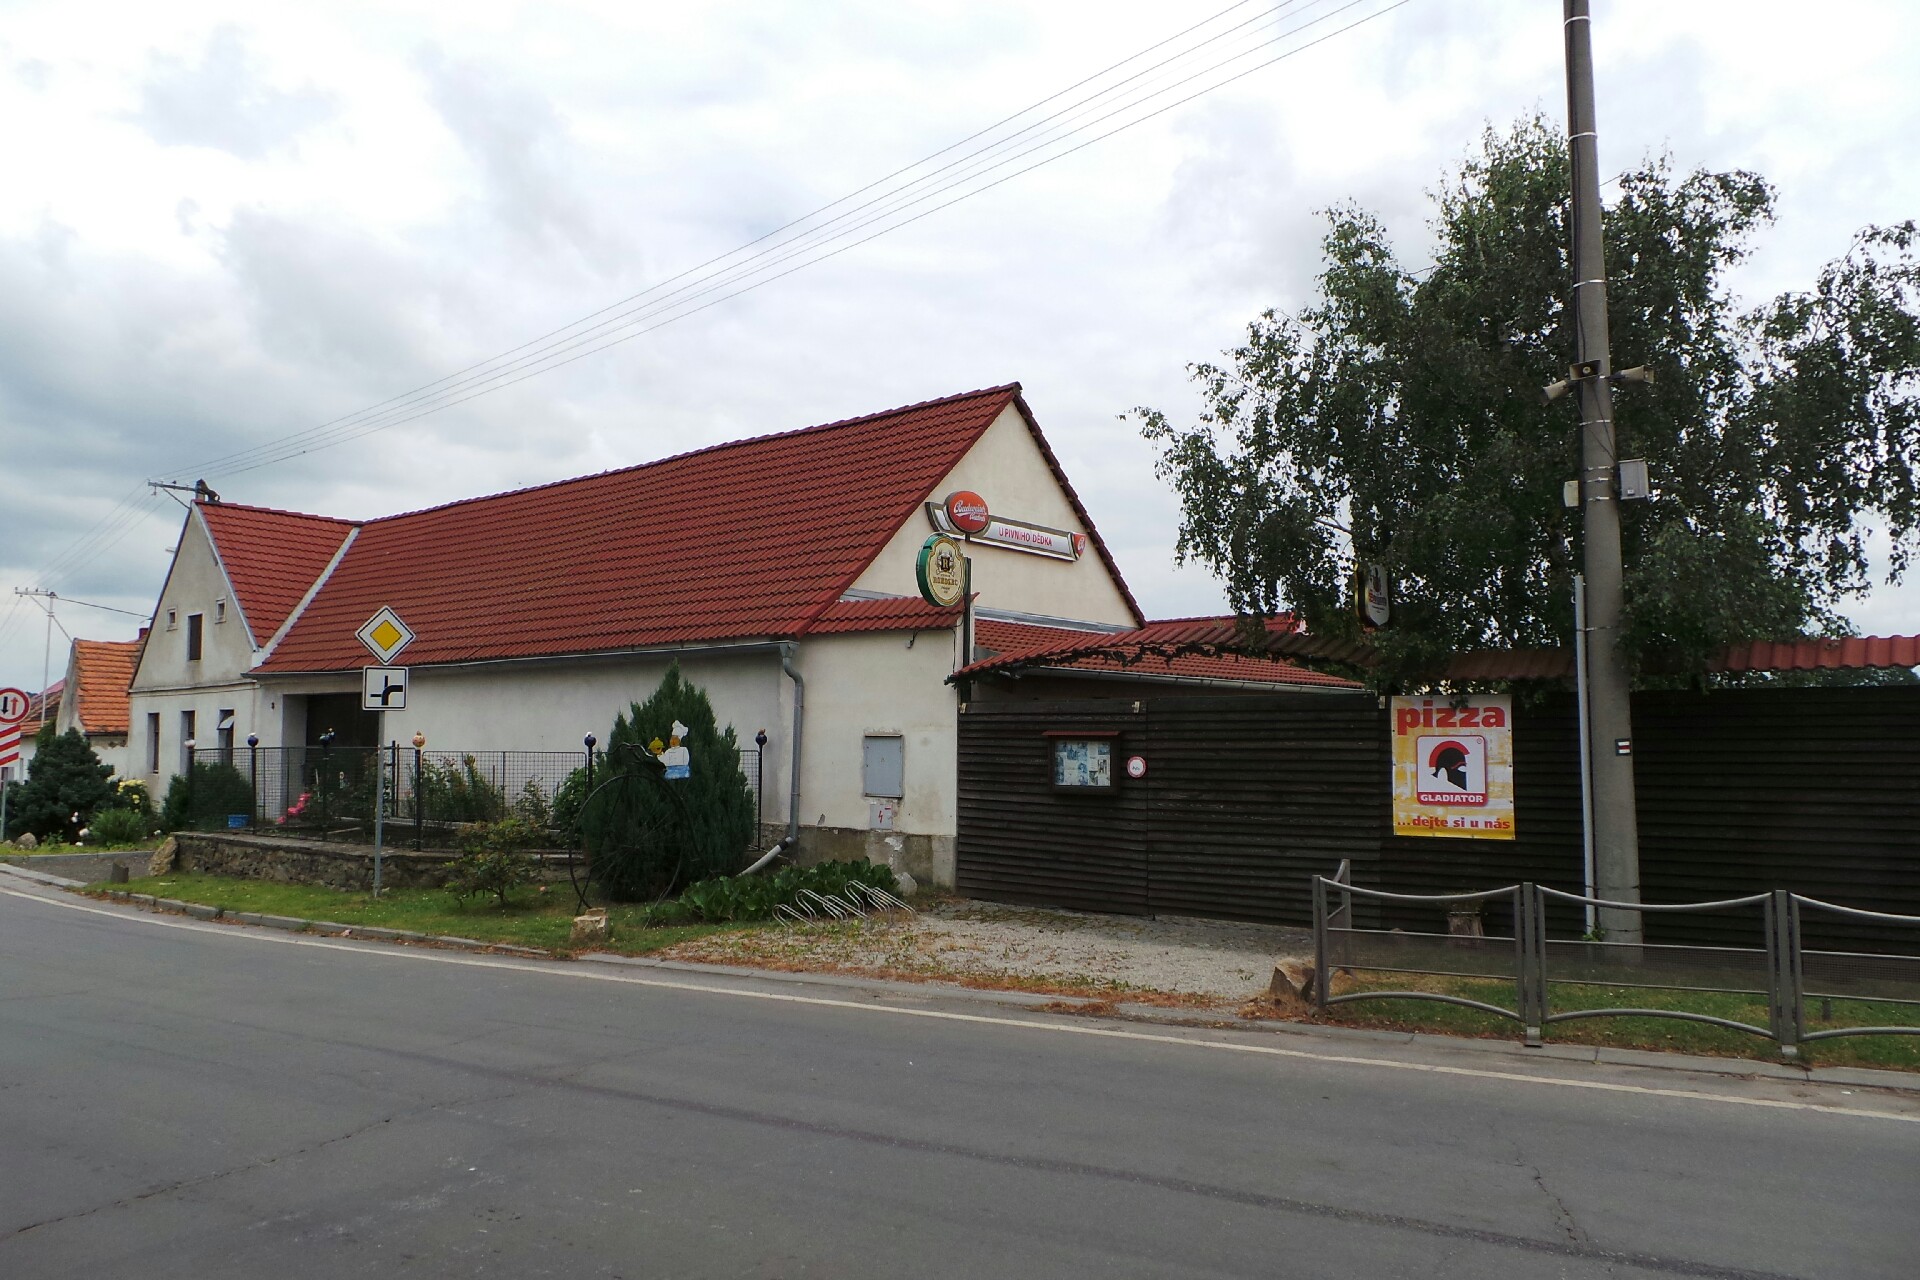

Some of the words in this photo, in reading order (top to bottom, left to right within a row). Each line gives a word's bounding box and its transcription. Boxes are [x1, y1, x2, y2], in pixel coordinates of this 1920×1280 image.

[999, 526, 1004, 537] U
[1397, 699, 1506, 735] pizza
[1420, 794, 1484, 803] GLADIATOR
[1453, 817, 1466, 828] si
[1470, 820, 1479, 828] u
[1484, 818, 1511, 829] nás
